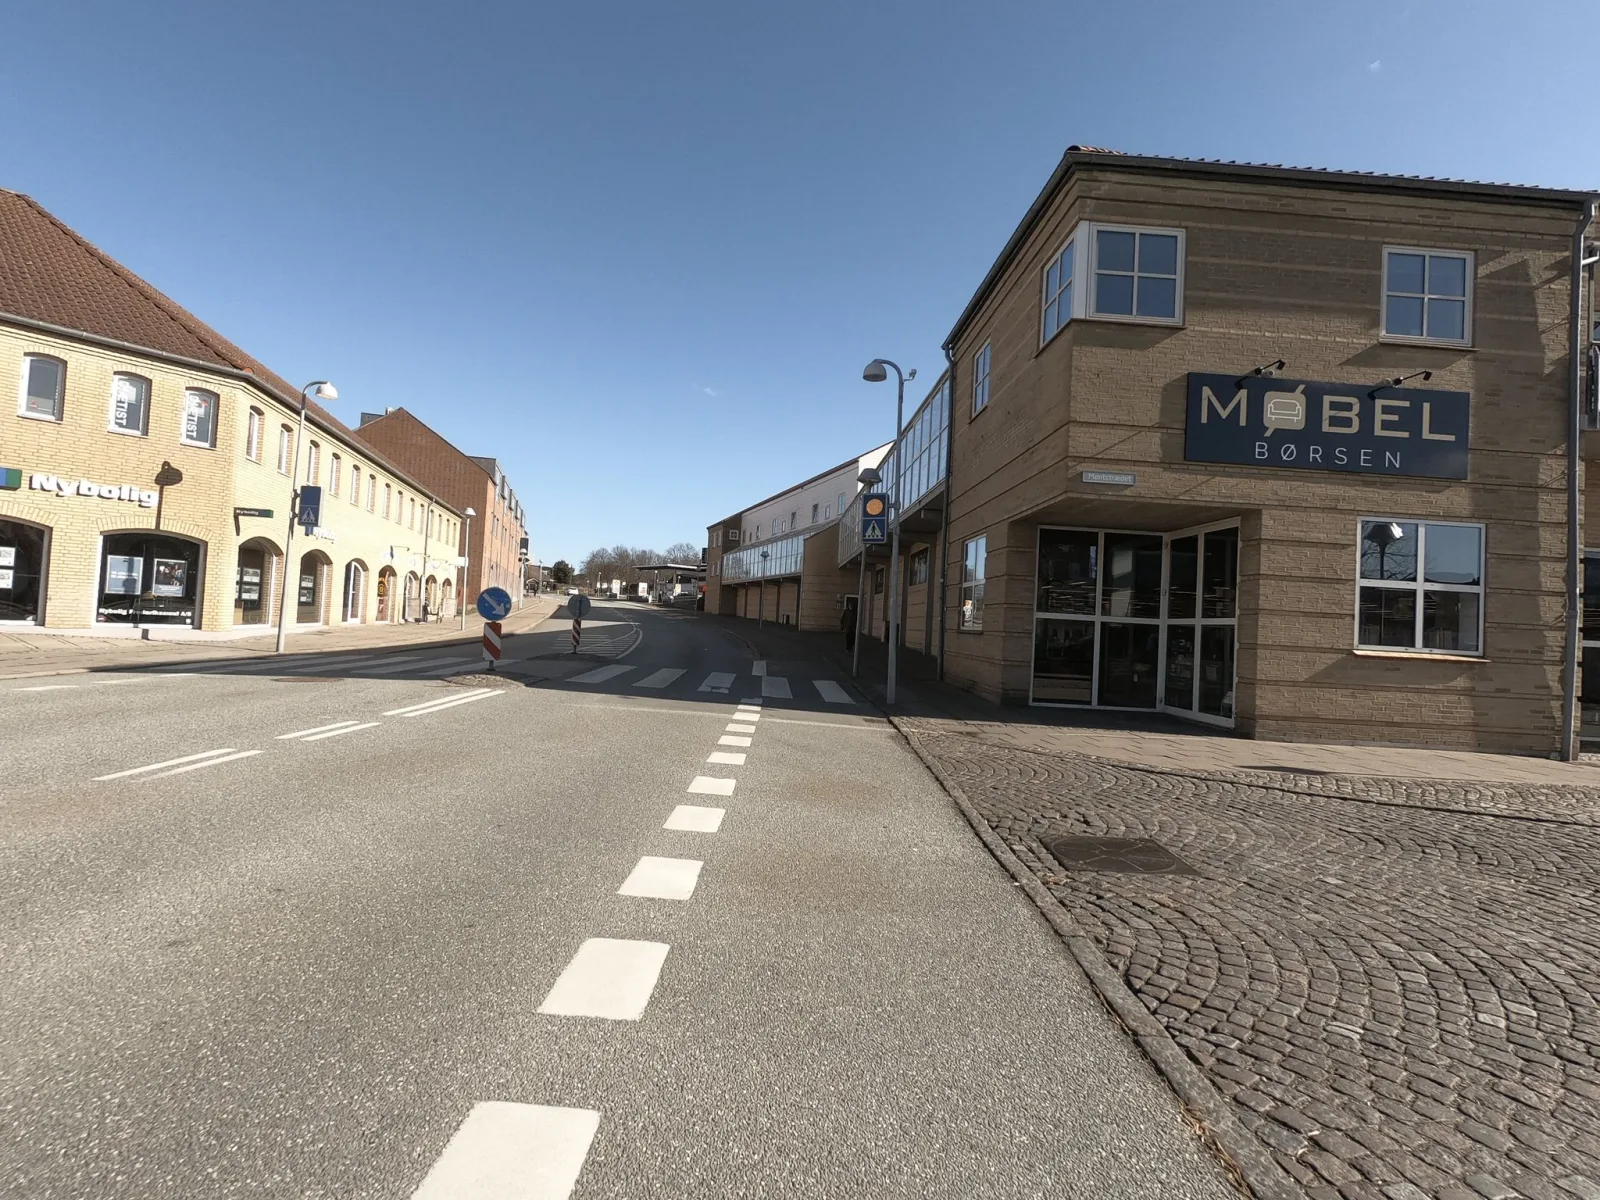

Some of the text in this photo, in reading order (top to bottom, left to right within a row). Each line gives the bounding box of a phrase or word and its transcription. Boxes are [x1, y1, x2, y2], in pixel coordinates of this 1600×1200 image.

[1201, 384, 1456, 442] MØBEL
[1255, 441, 1401, 468] BØRSEN
[31, 473, 160, 507] Nybolig
